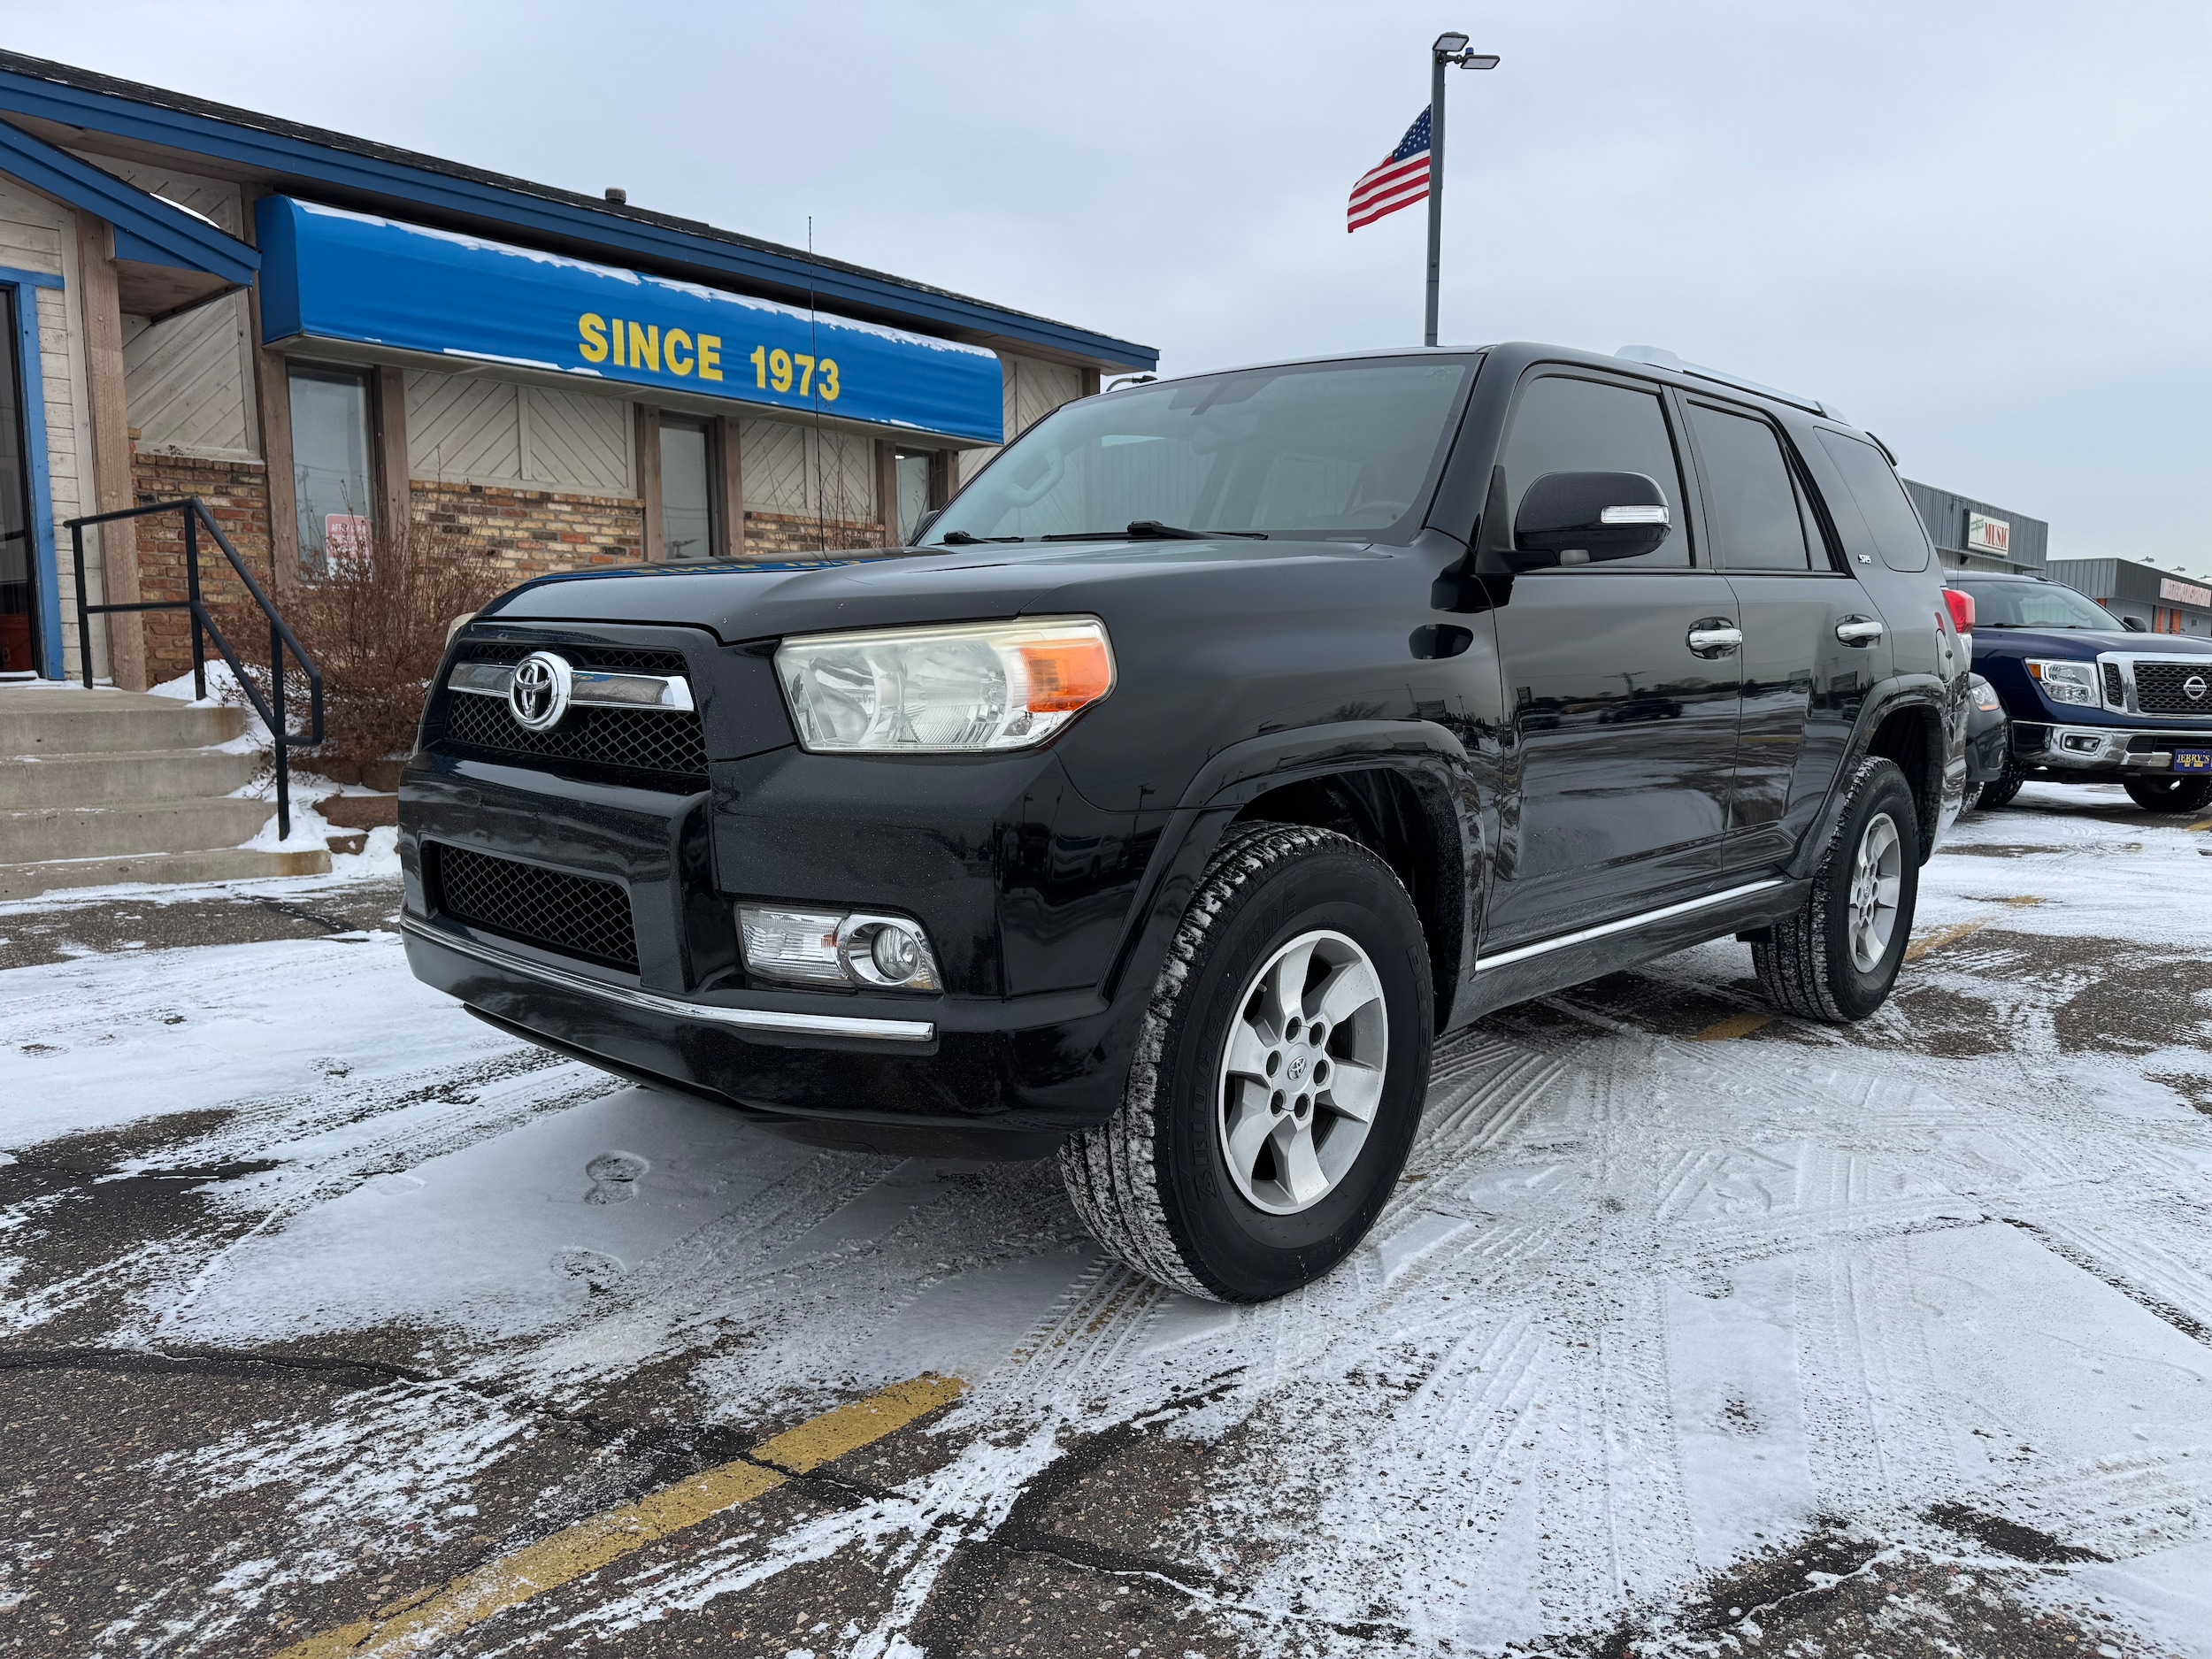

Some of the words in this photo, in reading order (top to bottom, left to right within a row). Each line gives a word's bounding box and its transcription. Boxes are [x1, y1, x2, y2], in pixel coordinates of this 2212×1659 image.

[578, 312, 723, 381] SINCE
[749, 345, 840, 401] 1973
[1983, 522, 2008, 549] MUSIC
[1193, 895, 1297, 1202] BRIDGESTONE
